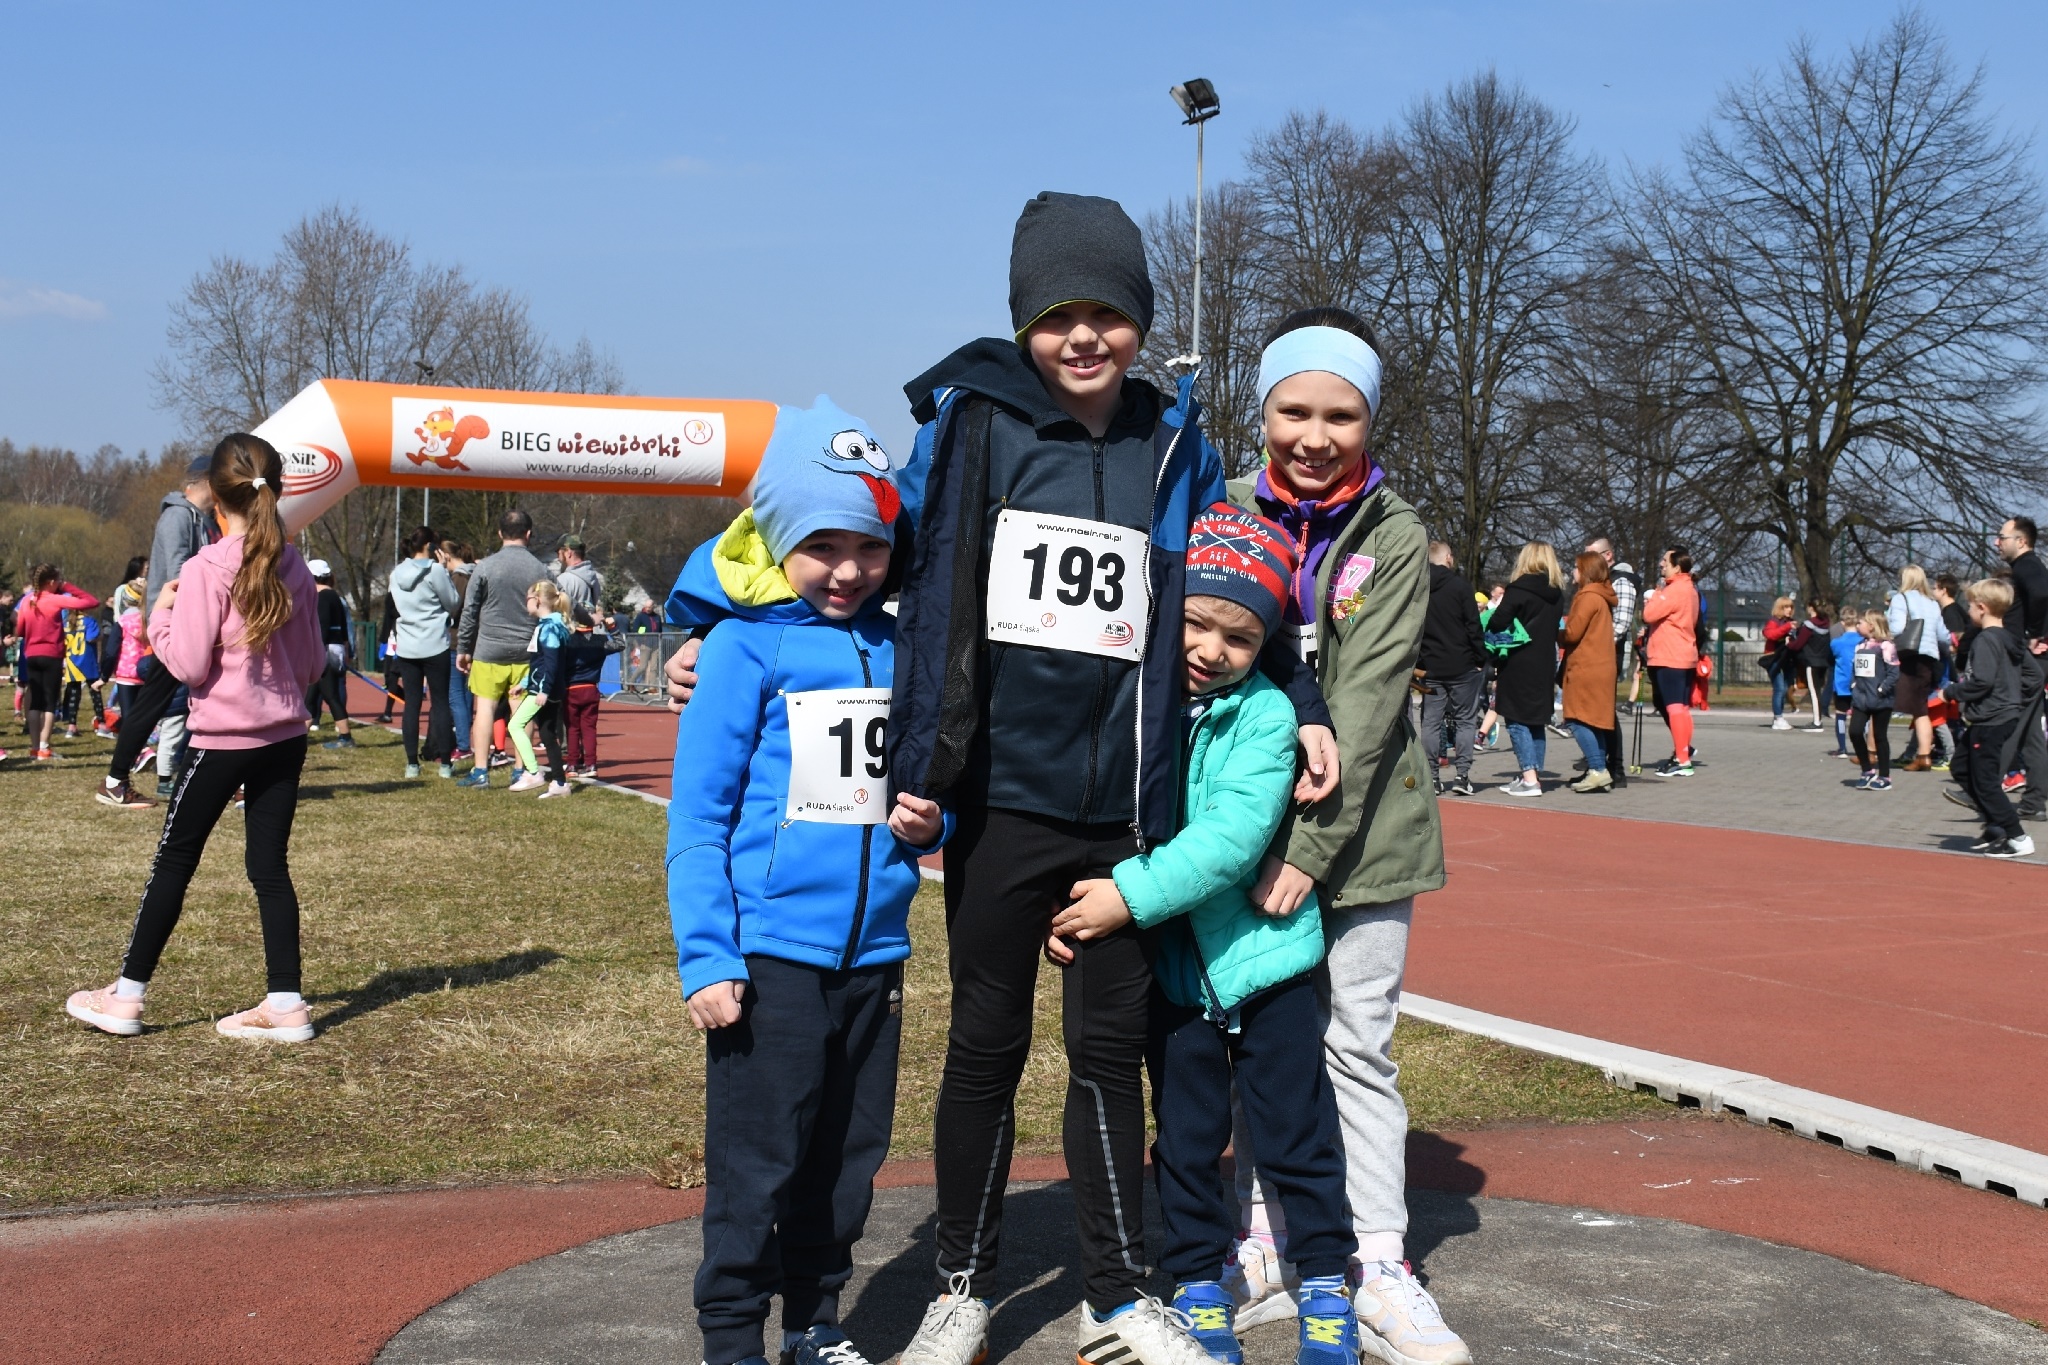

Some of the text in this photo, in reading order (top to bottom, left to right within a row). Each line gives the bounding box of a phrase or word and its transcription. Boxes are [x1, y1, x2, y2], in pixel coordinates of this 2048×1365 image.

[501, 431, 682, 458] BIEG wiewiórki
[526, 462, 656, 477] www.rudaslaska.pl
[1237, 513, 1273, 543] HEADS
[1023, 543, 1125, 612] 193
[997, 621, 1018, 630] RUDA
[828, 717, 888, 779] 19
[806, 801, 832, 811] RUDA
